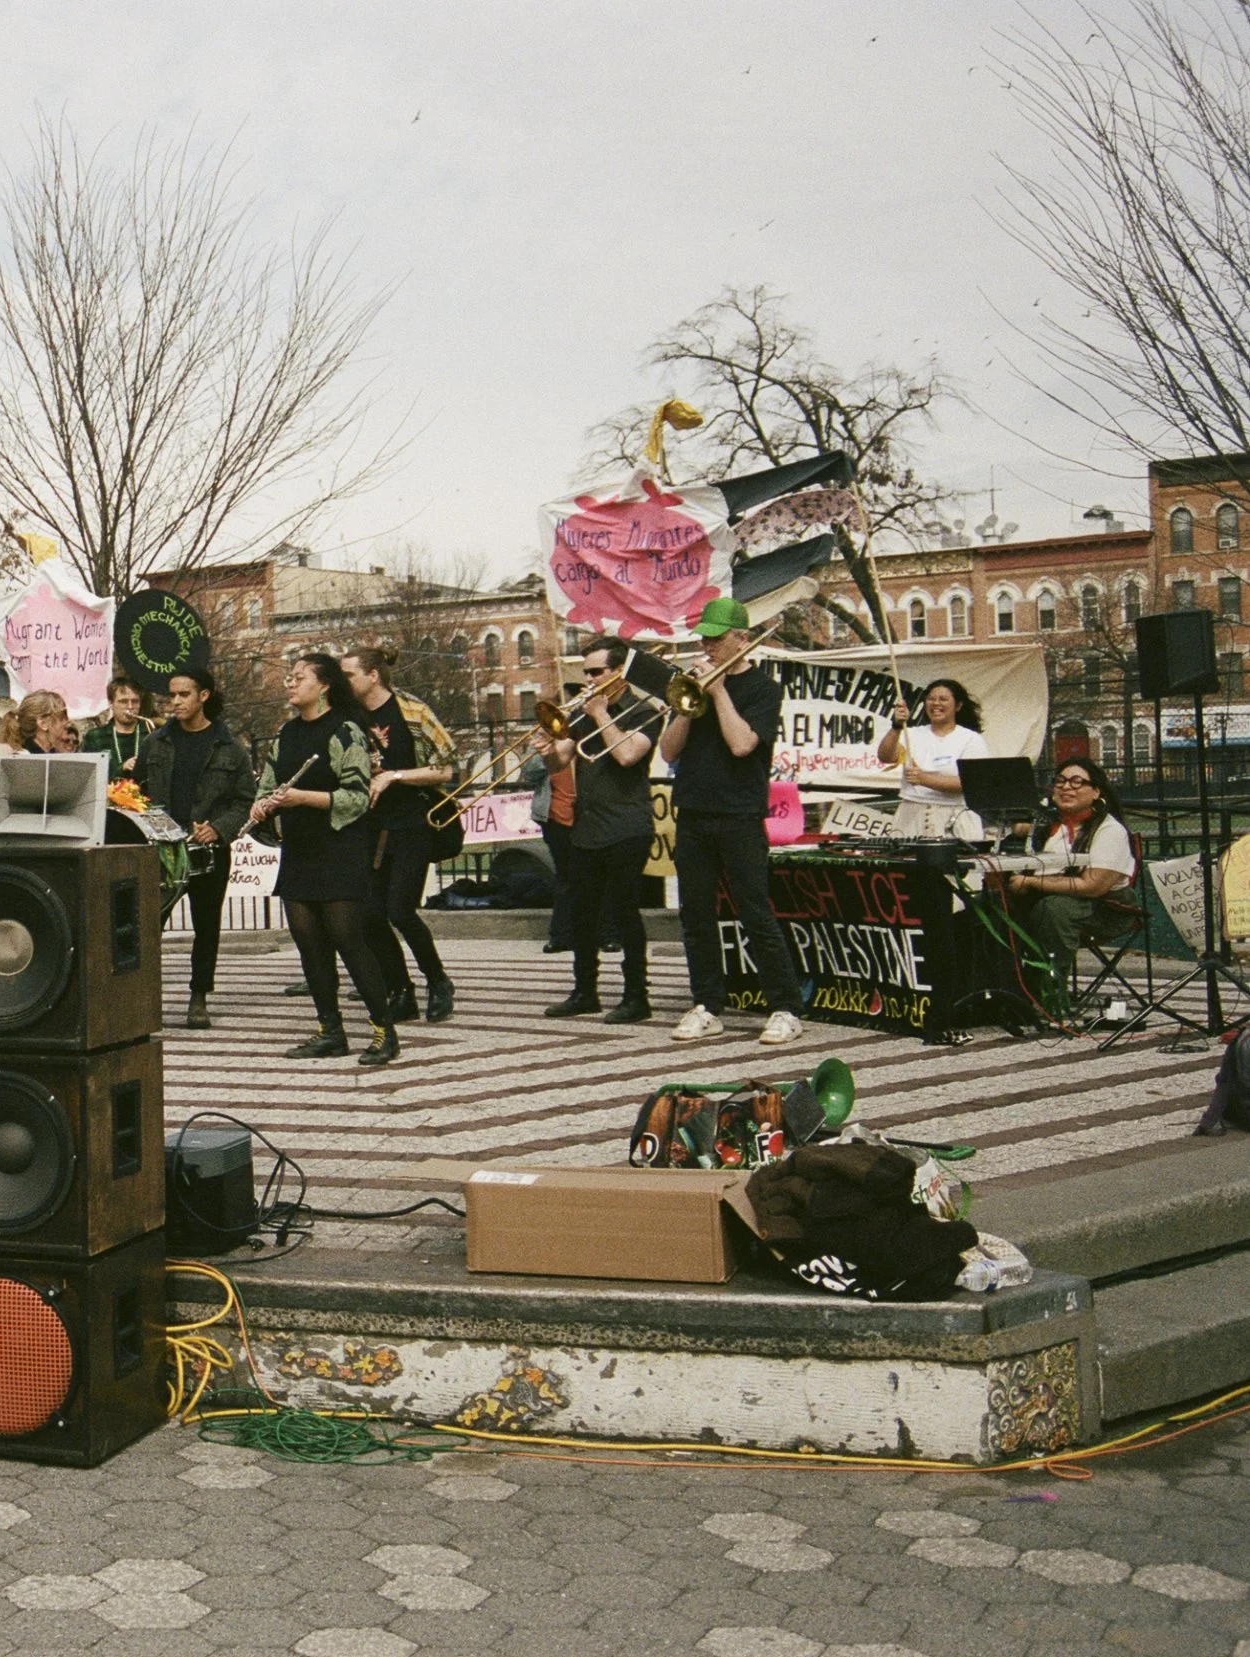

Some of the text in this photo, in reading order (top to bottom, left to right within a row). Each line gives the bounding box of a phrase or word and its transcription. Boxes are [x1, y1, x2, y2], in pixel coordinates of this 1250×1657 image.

[554, 517, 613, 552] Mujeres
[614, 559, 633, 585] al
[5, 614, 108, 650] Migrant Women
[162, 595, 203, 640] RUDE
[130, 622, 177, 675] ORCHESTRA
[139, 610, 191, 664] MECHANICAL
[44, 652, 69, 669] the
[76, 646, 109, 673] World
[792, 713, 814, 747] EL
[819, 714, 875, 749] MUNDO
[831, 805, 895, 838] LIBER
[235, 854, 278, 866] LA LUCHA
[236, 842, 254, 853] QUE
[846, 870, 922, 926] ICE
[789, 920, 933, 992] PALESTINE
